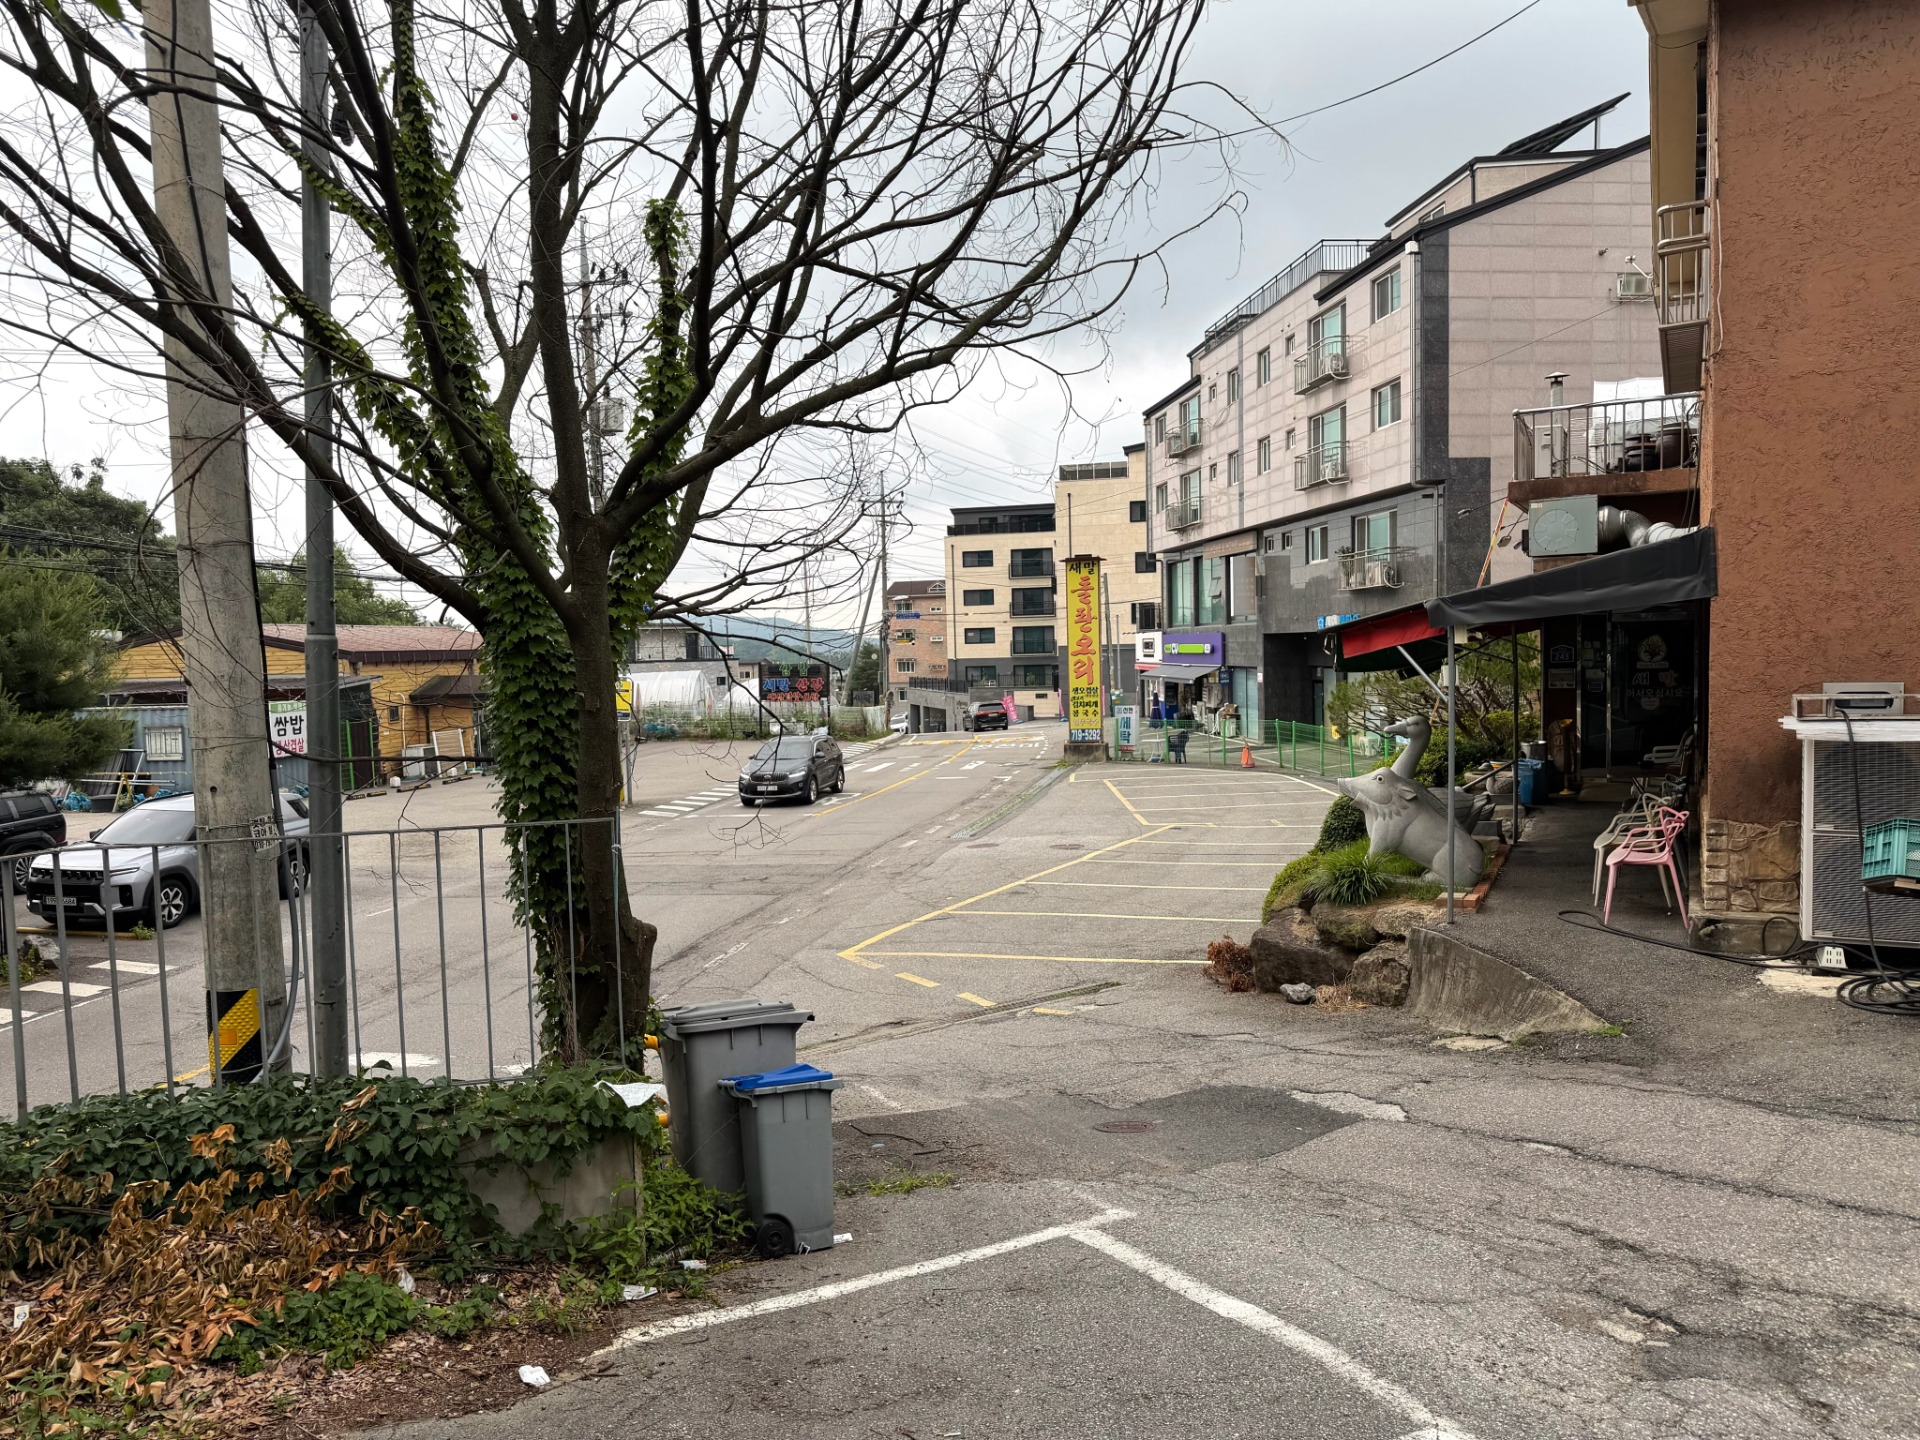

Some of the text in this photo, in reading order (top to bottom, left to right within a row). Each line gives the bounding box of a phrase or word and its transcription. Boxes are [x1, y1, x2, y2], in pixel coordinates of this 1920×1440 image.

[1069, 561, 1097, 575] 새말
[274, 715, 304, 737] 쌈밥
[1071, 729, 1101, 741] 719-5292
[1120, 717, 1131, 743] 세탁
